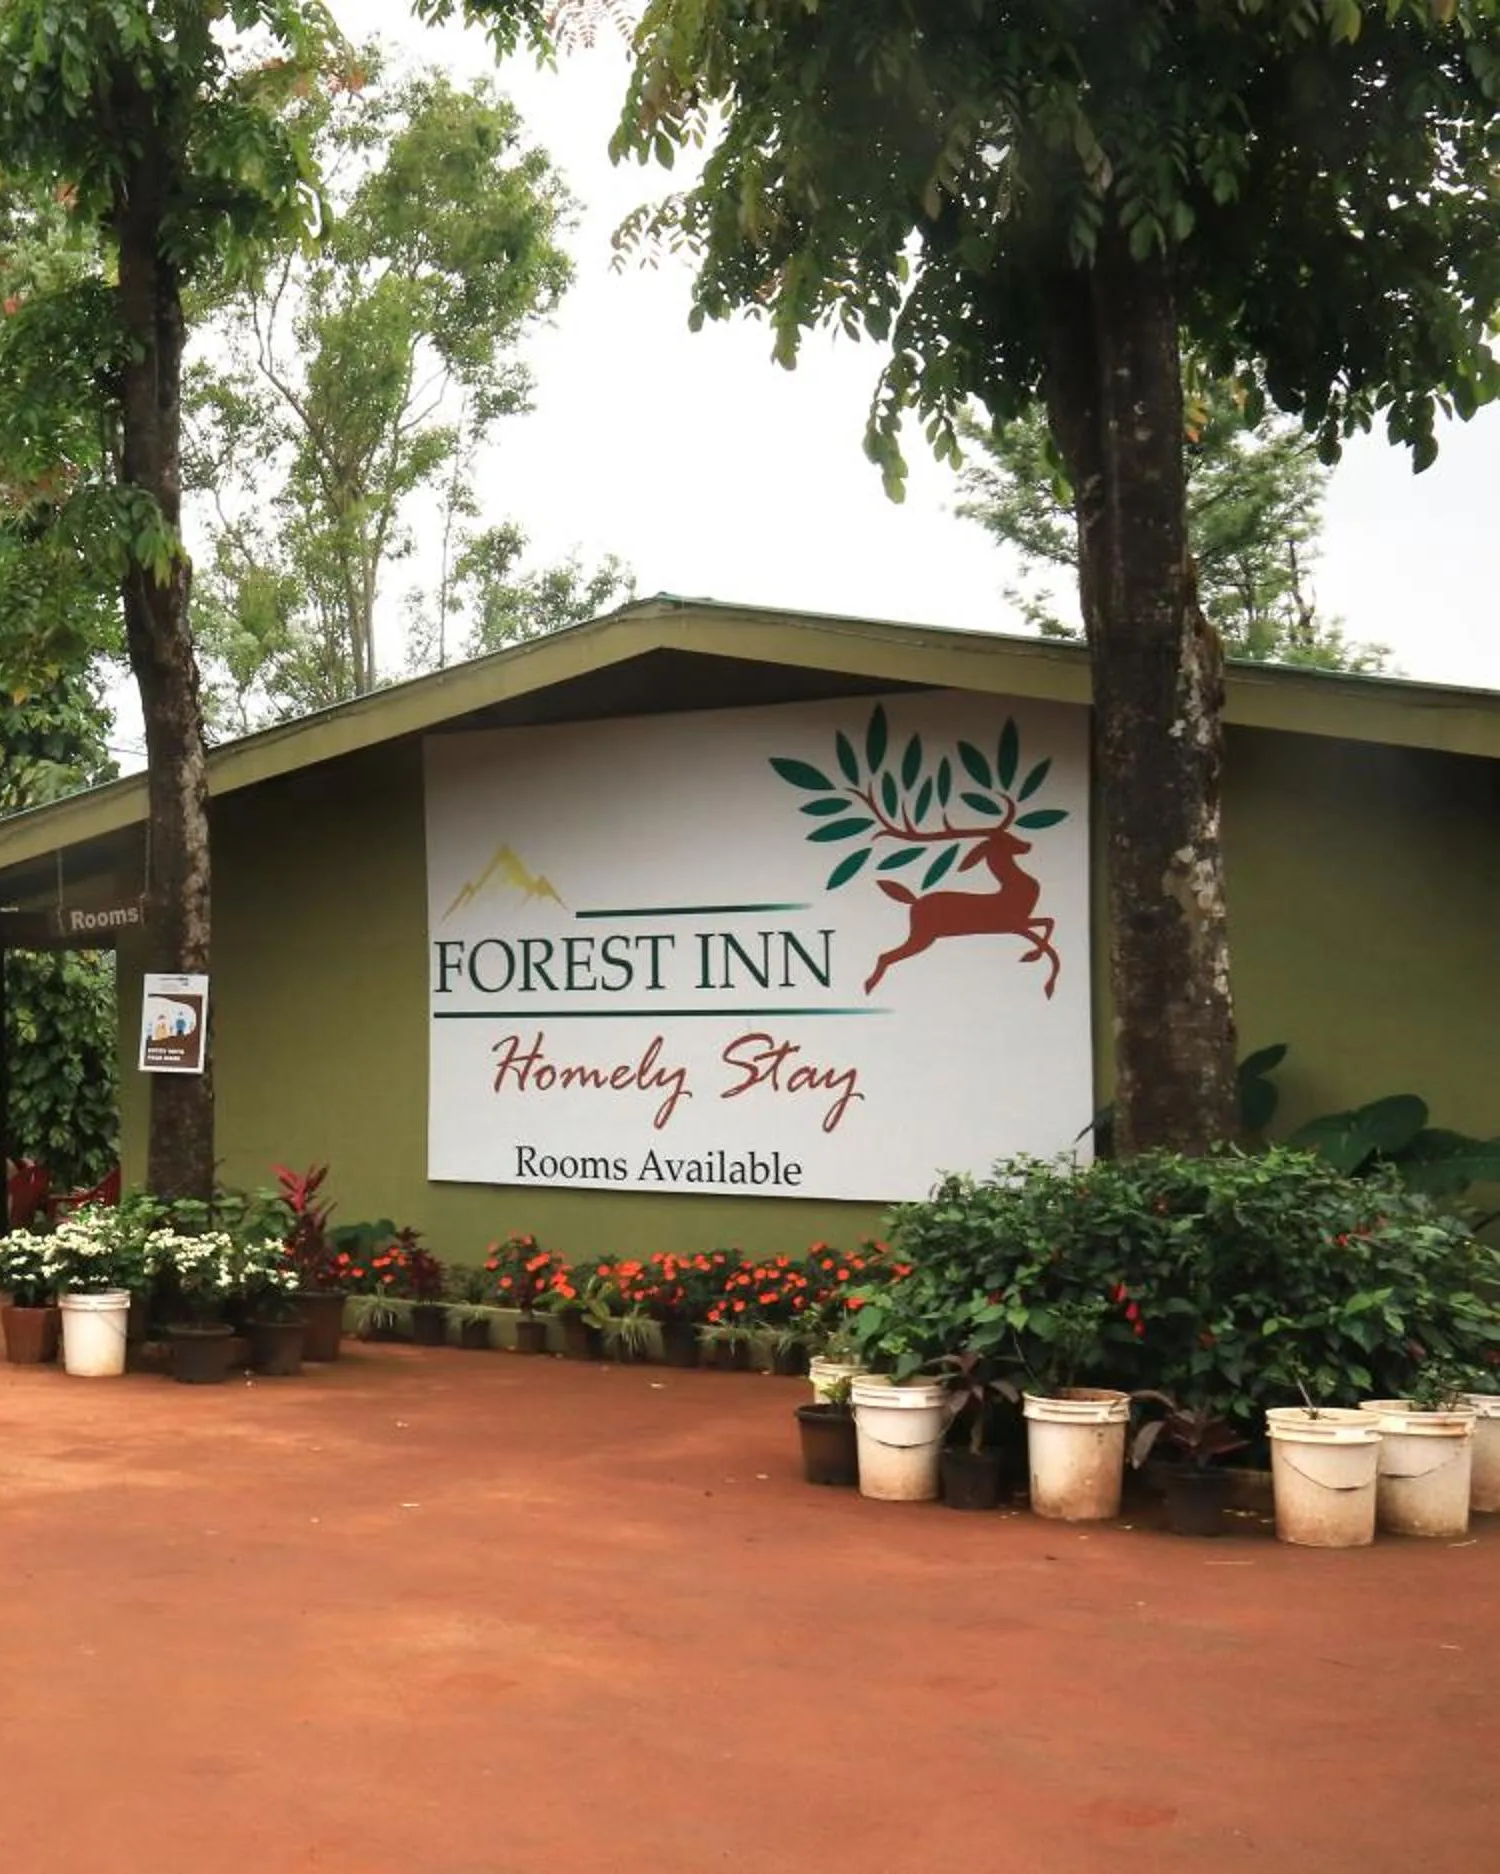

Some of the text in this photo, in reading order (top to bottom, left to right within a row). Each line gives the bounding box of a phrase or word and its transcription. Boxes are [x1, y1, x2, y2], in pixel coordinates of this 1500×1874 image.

[70, 907, 139, 930] Rooms
[433, 929, 836, 993] FOREST INN
[491, 1031, 865, 1133] Homely Stay
[514, 1146, 803, 1187] Rooms Available
